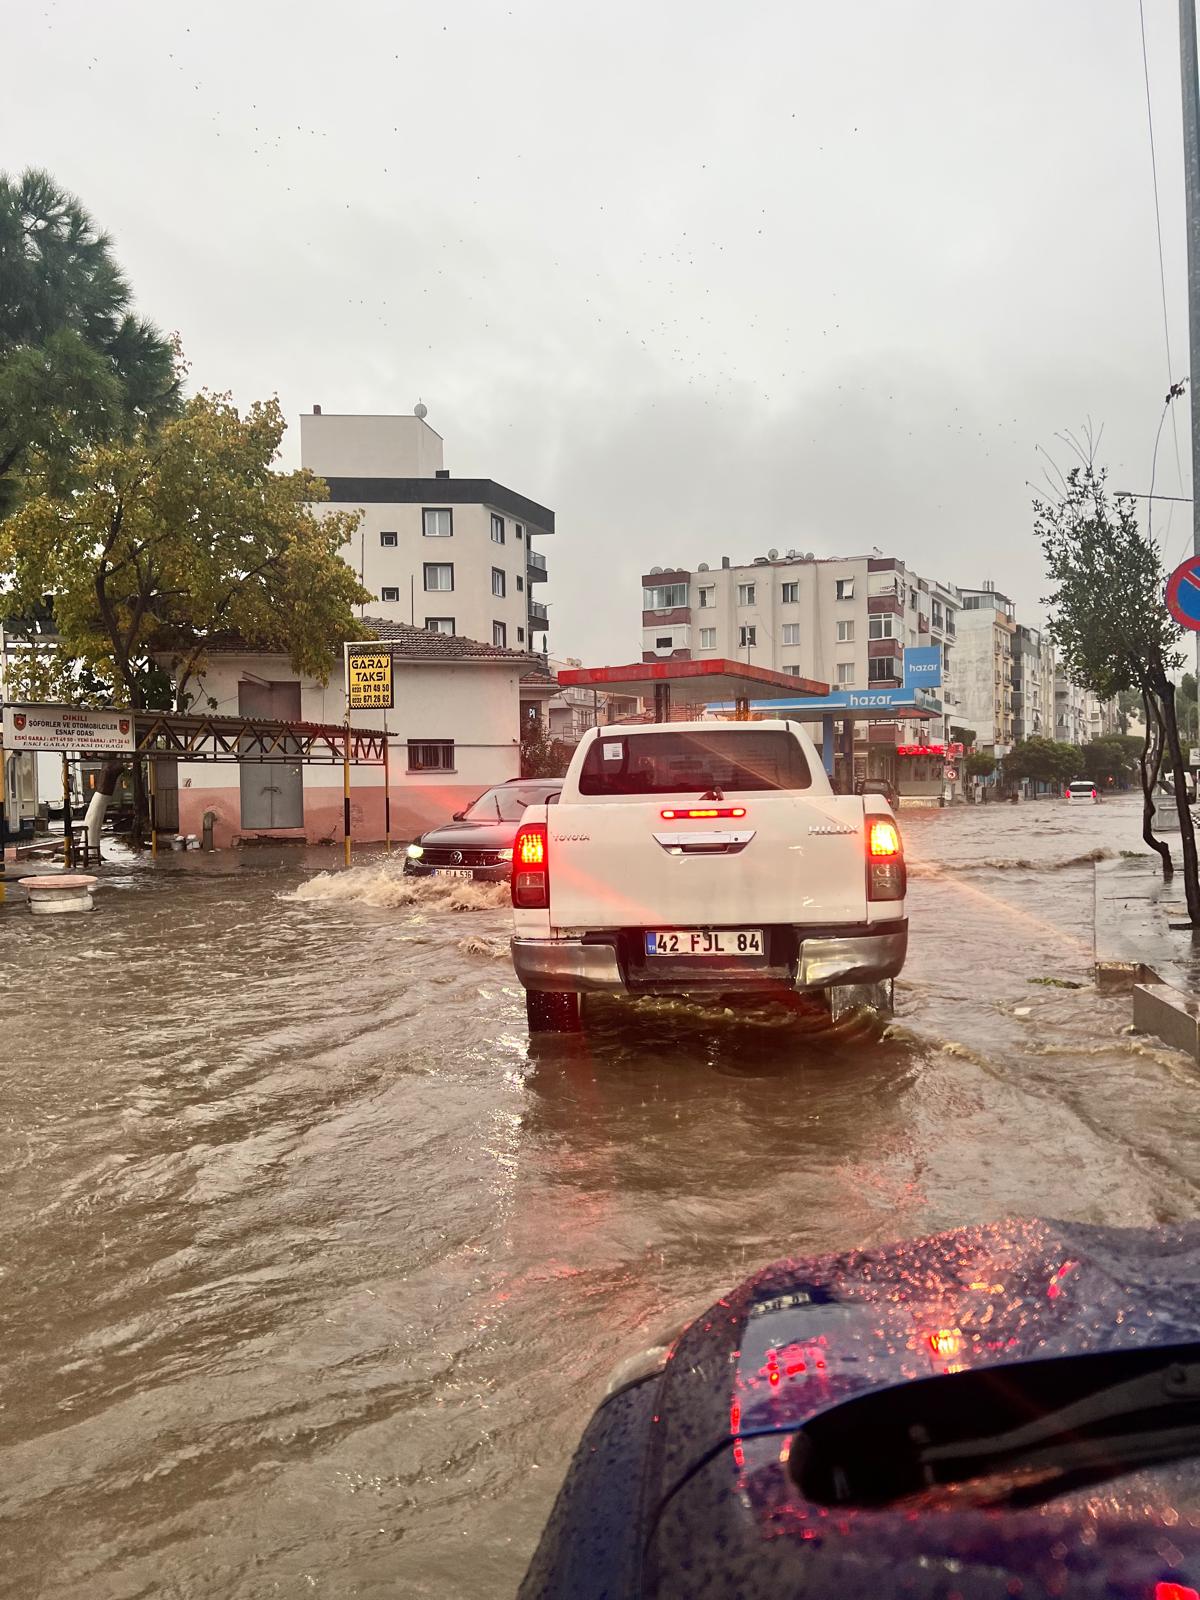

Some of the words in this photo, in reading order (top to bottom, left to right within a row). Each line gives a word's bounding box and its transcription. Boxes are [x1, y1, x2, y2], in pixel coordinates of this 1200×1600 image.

[352, 658, 389, 669] GARAJ
[909, 663, 938, 672] hazar
[356, 669, 386, 682] TAKSİ
[374, 684, 381, 692] 49
[382, 684, 389, 692] 50
[363, 695, 372, 703] 671
[374, 694, 381, 702] 26
[382, 694, 389, 702] 62
[850, 693, 892, 706] hazar
[553, 832, 590, 842] TOYOTA
[460, 870, 471, 878] 536
[658, 934, 679, 952] 42
[690, 934, 724, 952] FJL
[737, 933, 759, 951] 84
